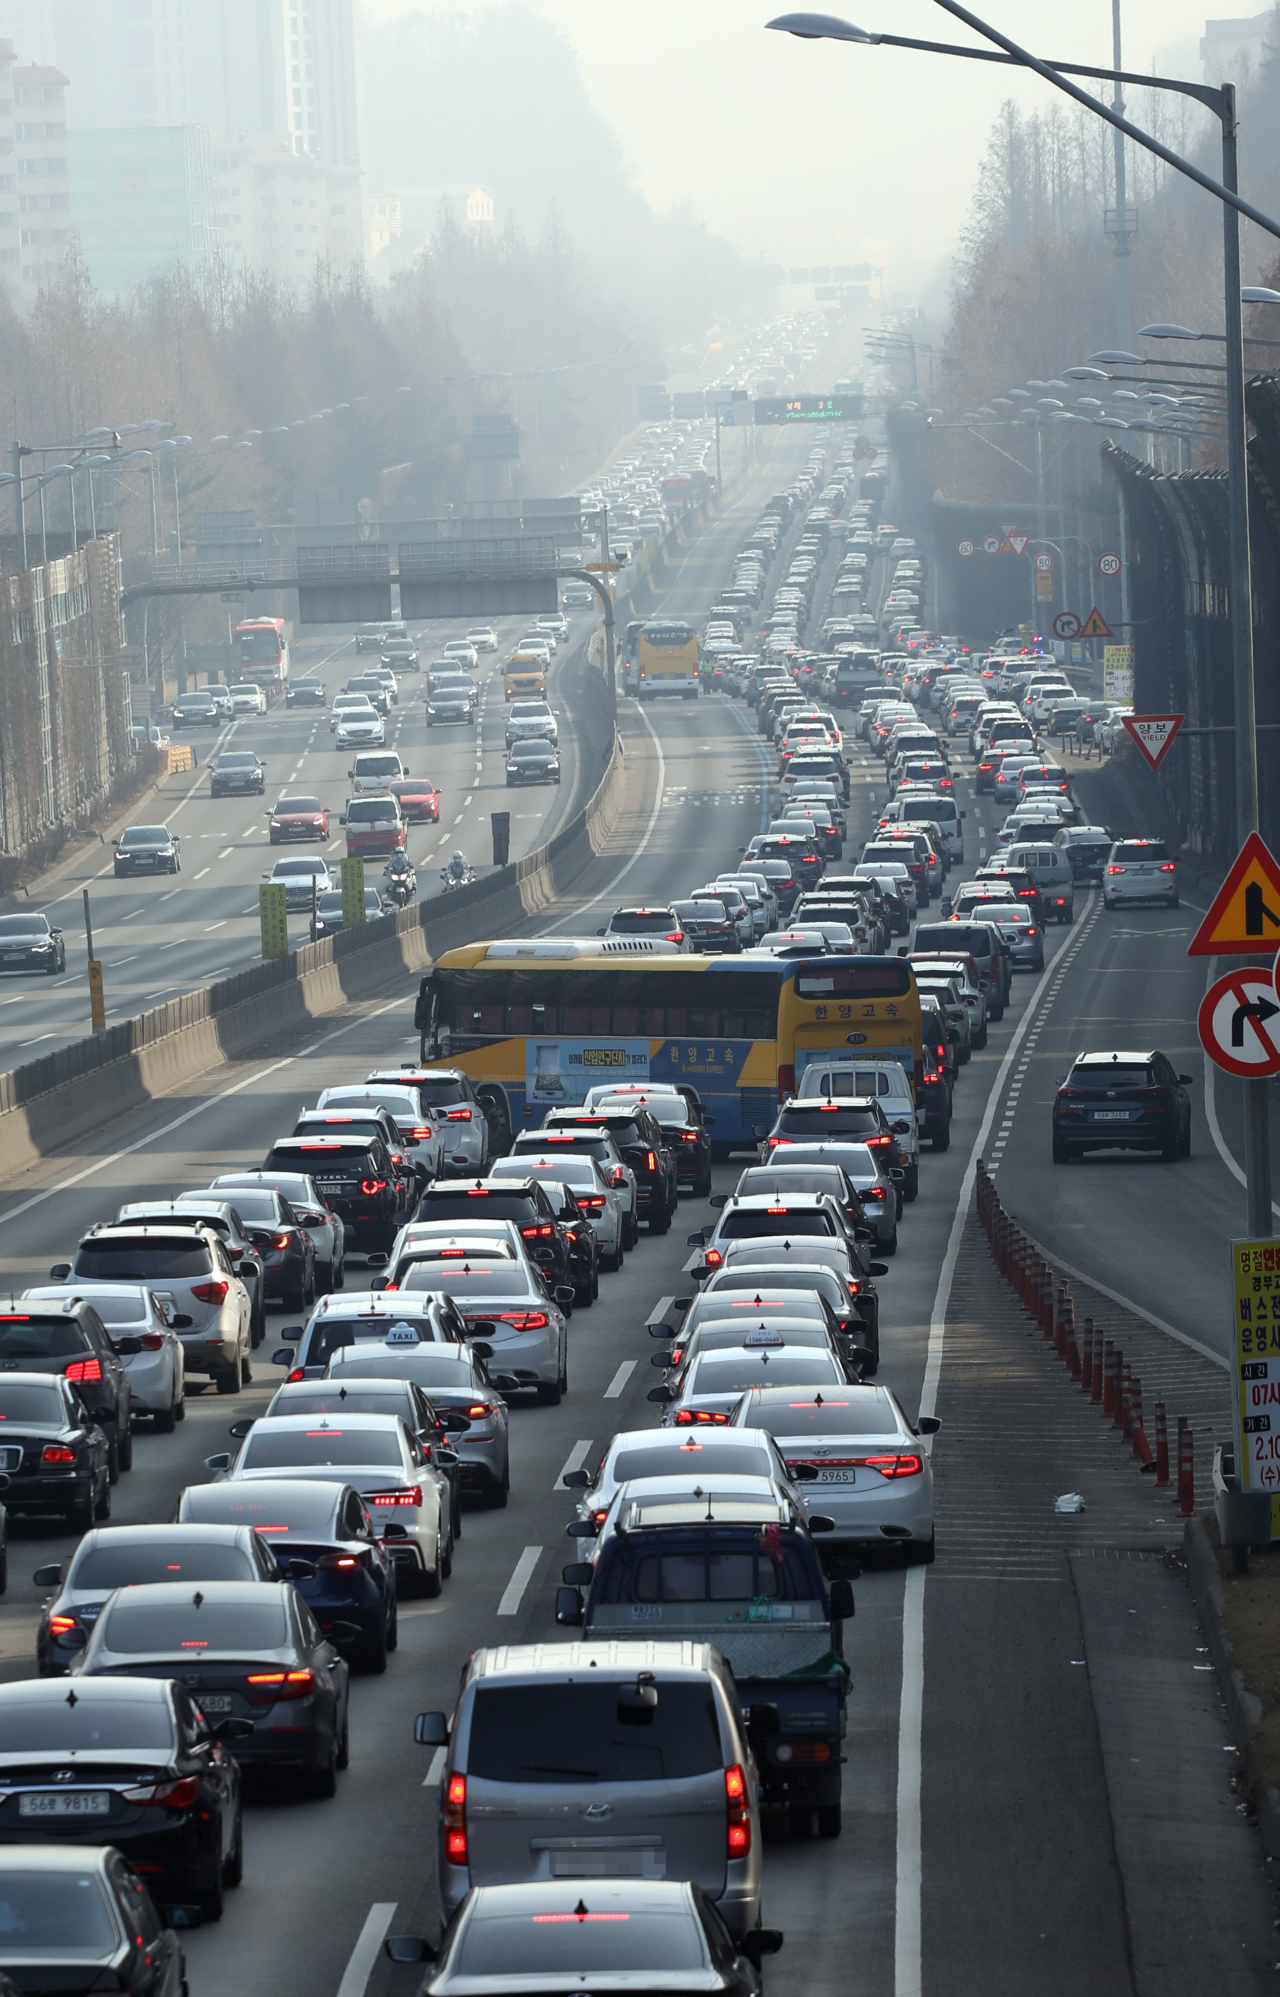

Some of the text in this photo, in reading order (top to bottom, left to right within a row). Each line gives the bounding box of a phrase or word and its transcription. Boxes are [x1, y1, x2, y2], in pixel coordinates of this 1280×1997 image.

[960, 543, 972, 554] 80
[1038, 558, 1050, 567] 80
[1103, 559, 1117, 571] 80
[1139, 723, 1168, 735] 양보
[1142, 734, 1166, 742] YIELD
[849, 1034, 865, 1043] KIA
[706, 1065, 724, 1074] EXPRESS
[1244, 1365, 1266, 1378] 시간
[1246, 1418, 1268, 1431] 기간
[821, 1471, 849, 1482] 5965
[63, 1795, 100, 1810] 9815
